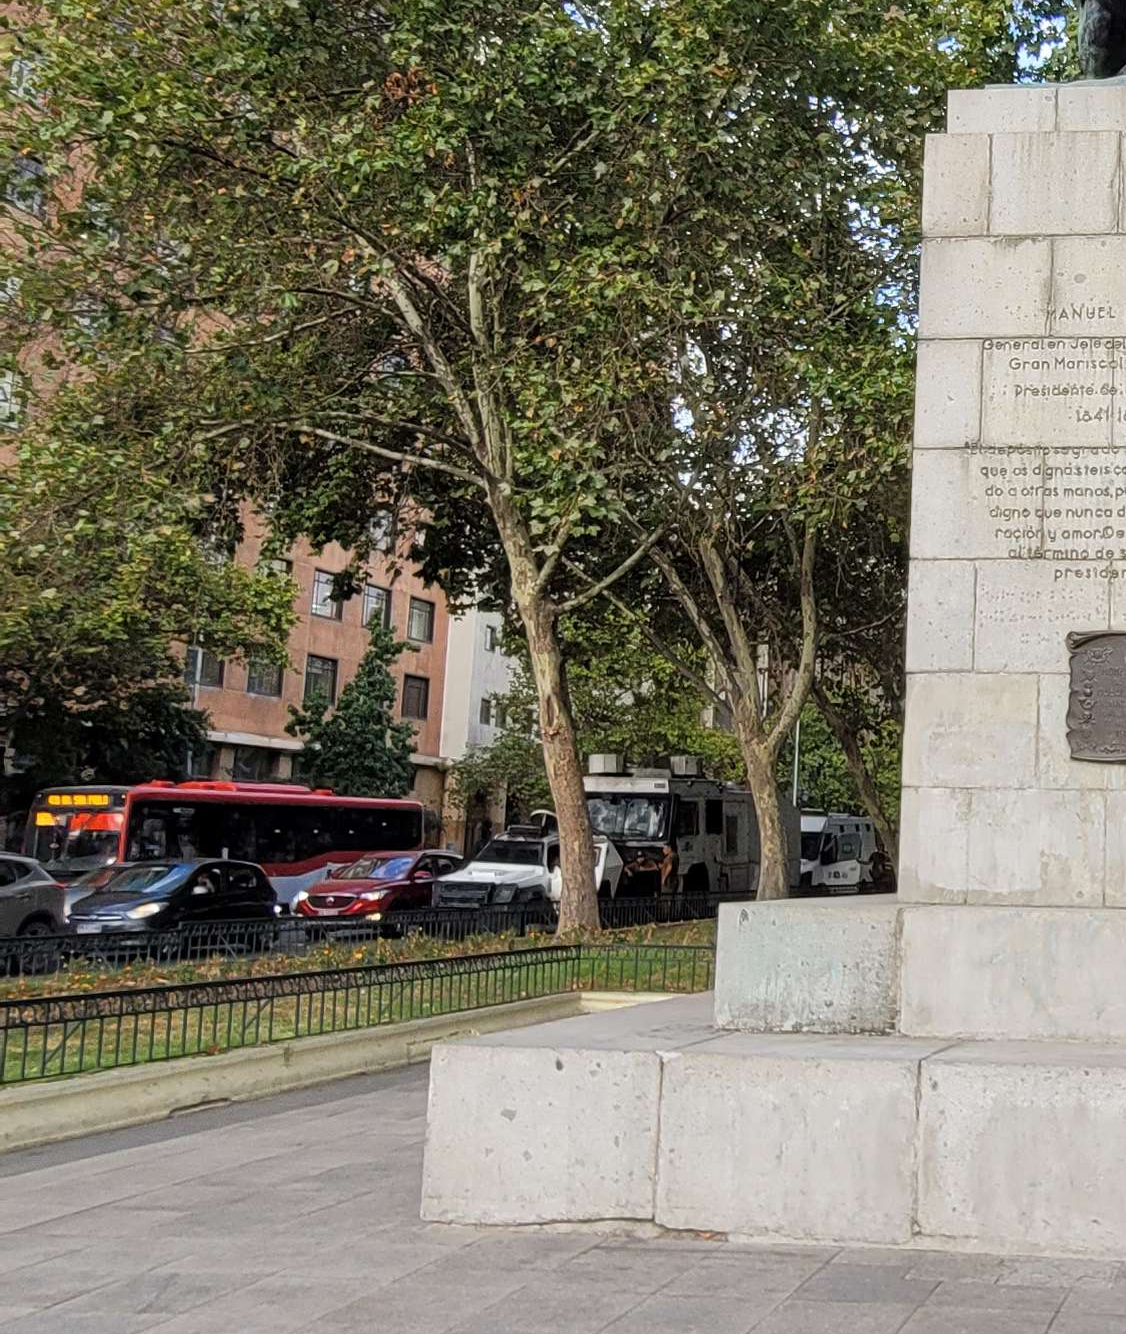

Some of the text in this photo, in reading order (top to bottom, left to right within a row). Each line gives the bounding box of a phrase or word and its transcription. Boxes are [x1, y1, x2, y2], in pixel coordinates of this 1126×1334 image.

[1041, 304, 1116, 320] MANUEL
[982, 338, 1045, 350] General
[1047, 340, 1066, 349] en
[1009, 357, 1050, 370] Gran
[1054, 356, 1124, 371] Mariscal
[1015, 383, 1095, 397] Presidente
[1099, 382, 1118, 396] de
[980, 466, 1008, 479] que
[1012, 466, 1028, 476] os
[984, 485, 1004, 497] do
[1007, 487, 1018, 496] a
[1021, 485, 1060, 497] otras
[1063, 486, 1114, 499] manos,
[988, 505, 1031, 521] digno
[1034, 507, 1062, 521] que
[1065, 507, 1113, 518] nunca
[995, 524, 1045, 540] ración
[1047, 528, 1057, 542] y
[1095, 546, 1115, 559] de
